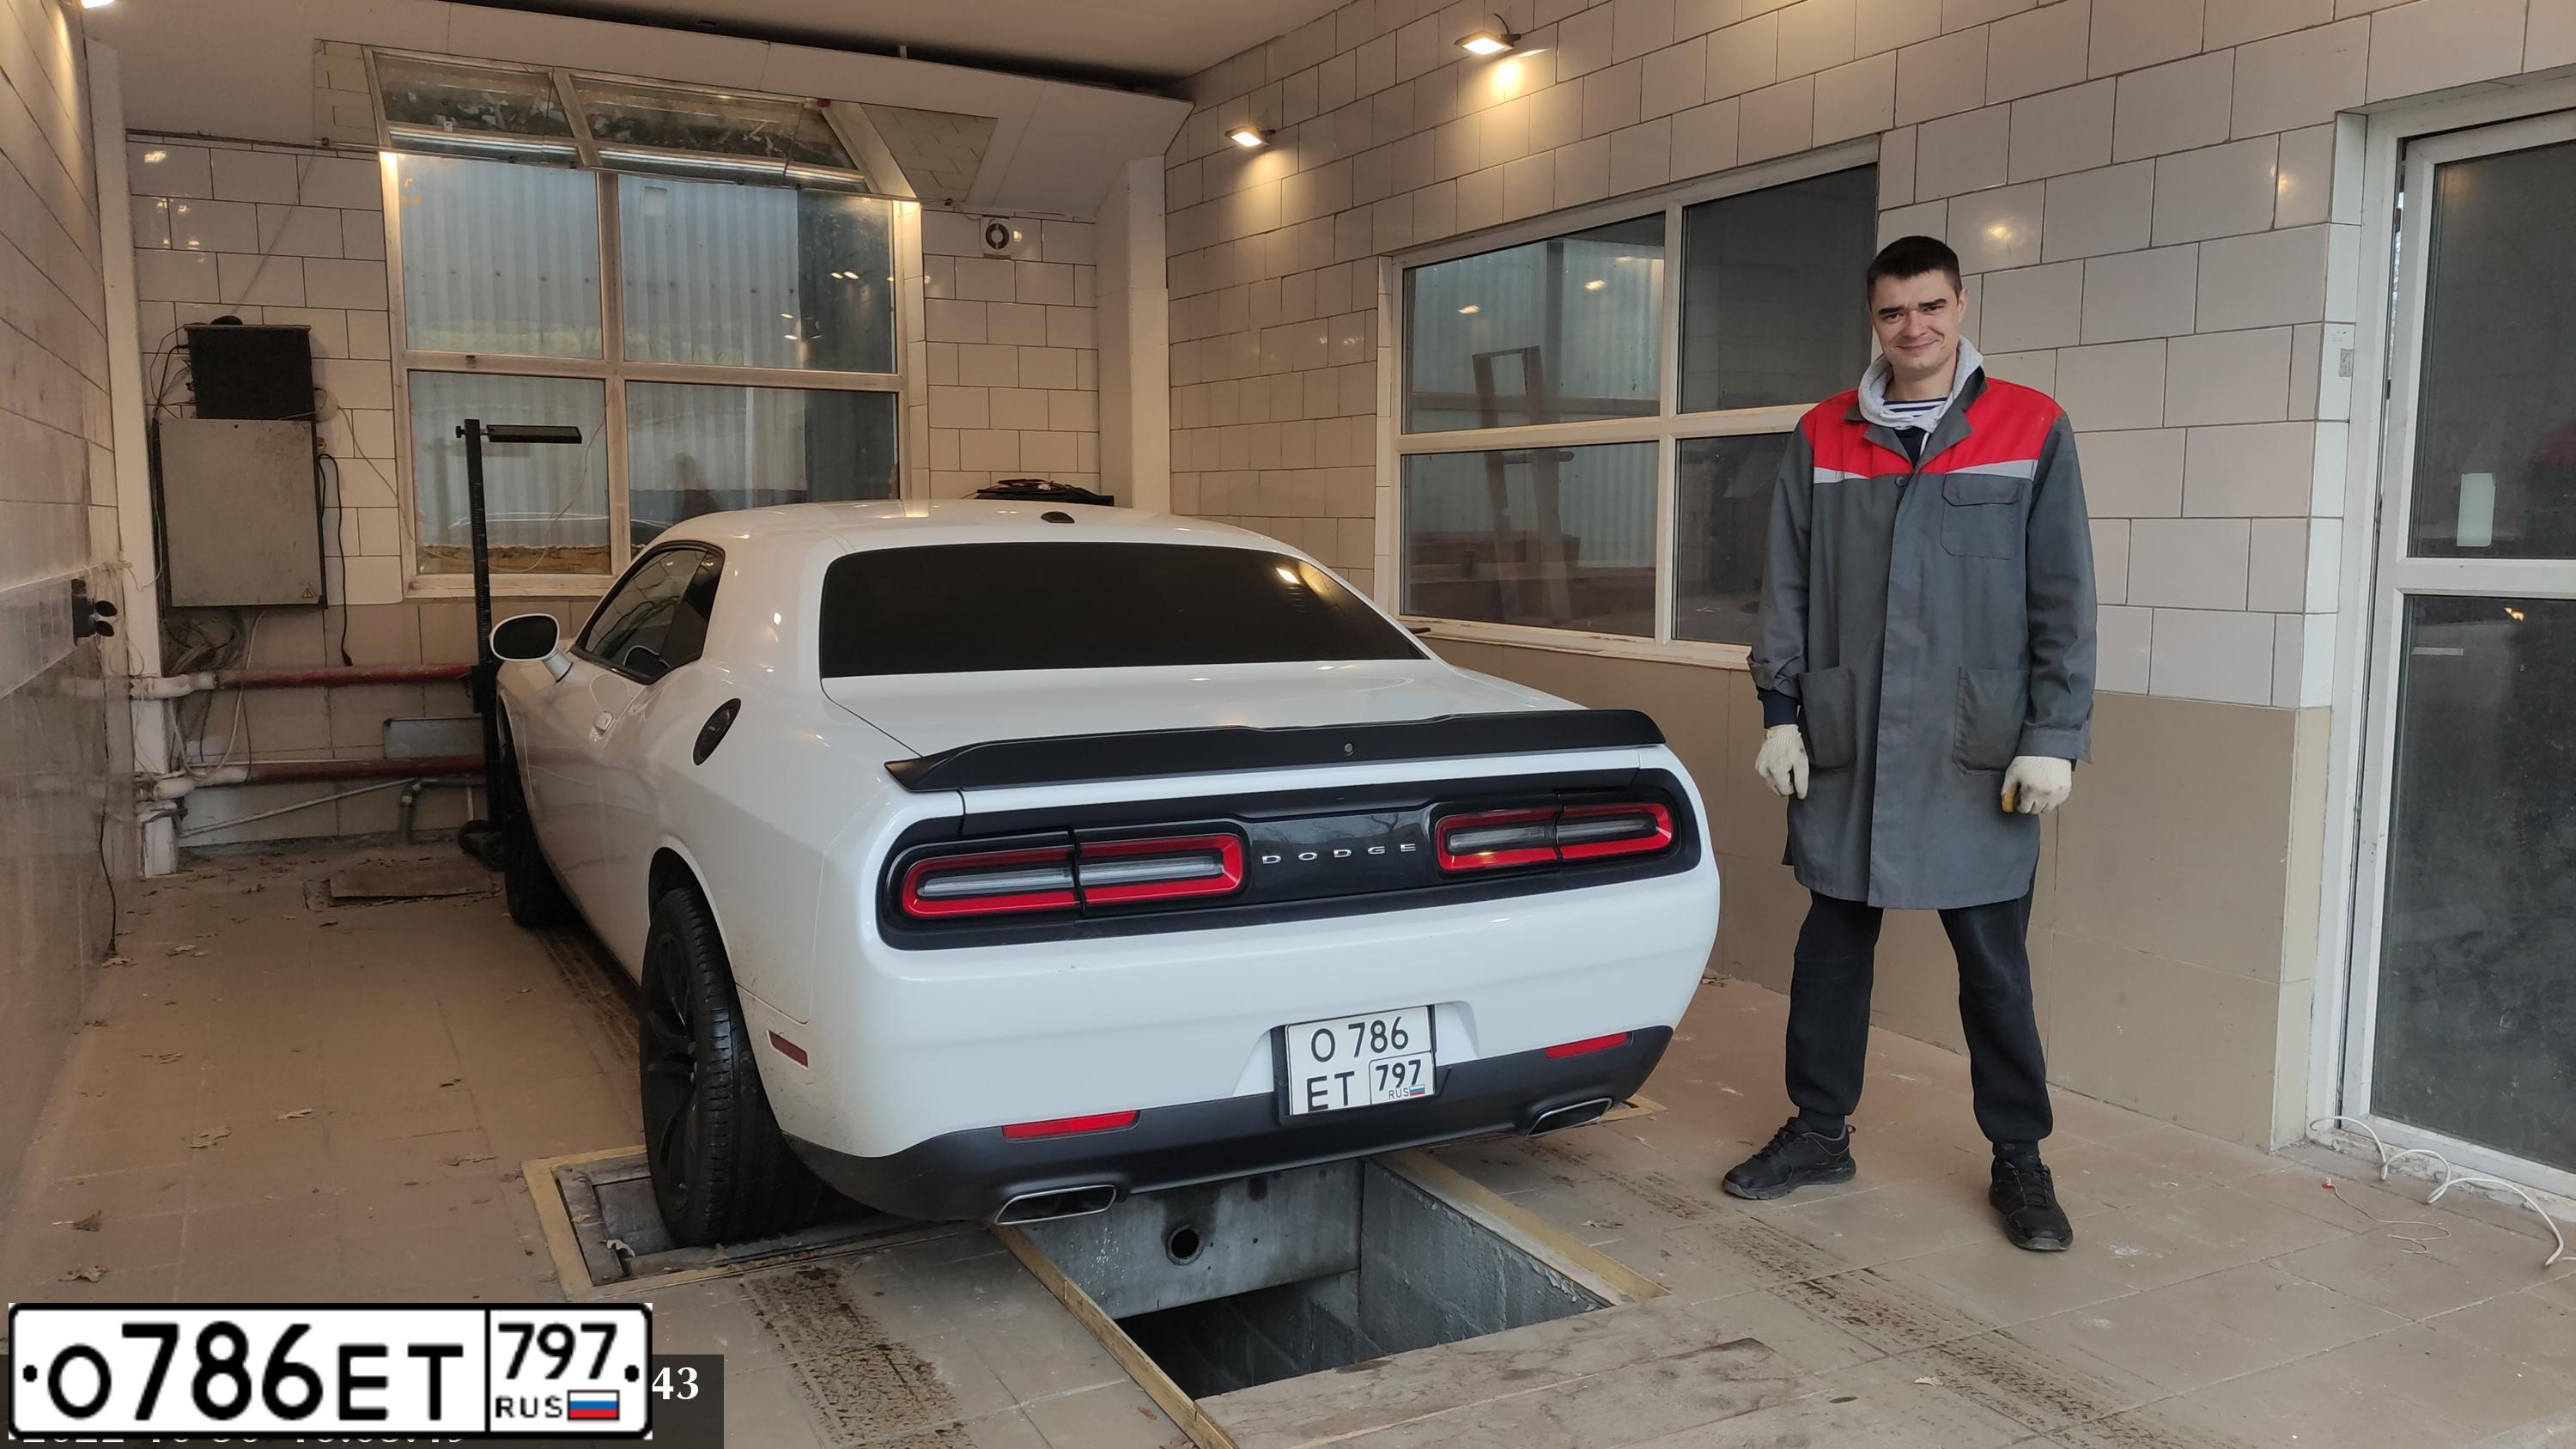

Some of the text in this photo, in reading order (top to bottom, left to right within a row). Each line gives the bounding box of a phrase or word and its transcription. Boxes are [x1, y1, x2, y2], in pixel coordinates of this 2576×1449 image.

[1261, 843, 1417, 864] DODGE
[1376, 1058, 1422, 1092] 797
[1306, 1070, 1355, 1112] ET
[1388, 1087, 1410, 1099] RUS
